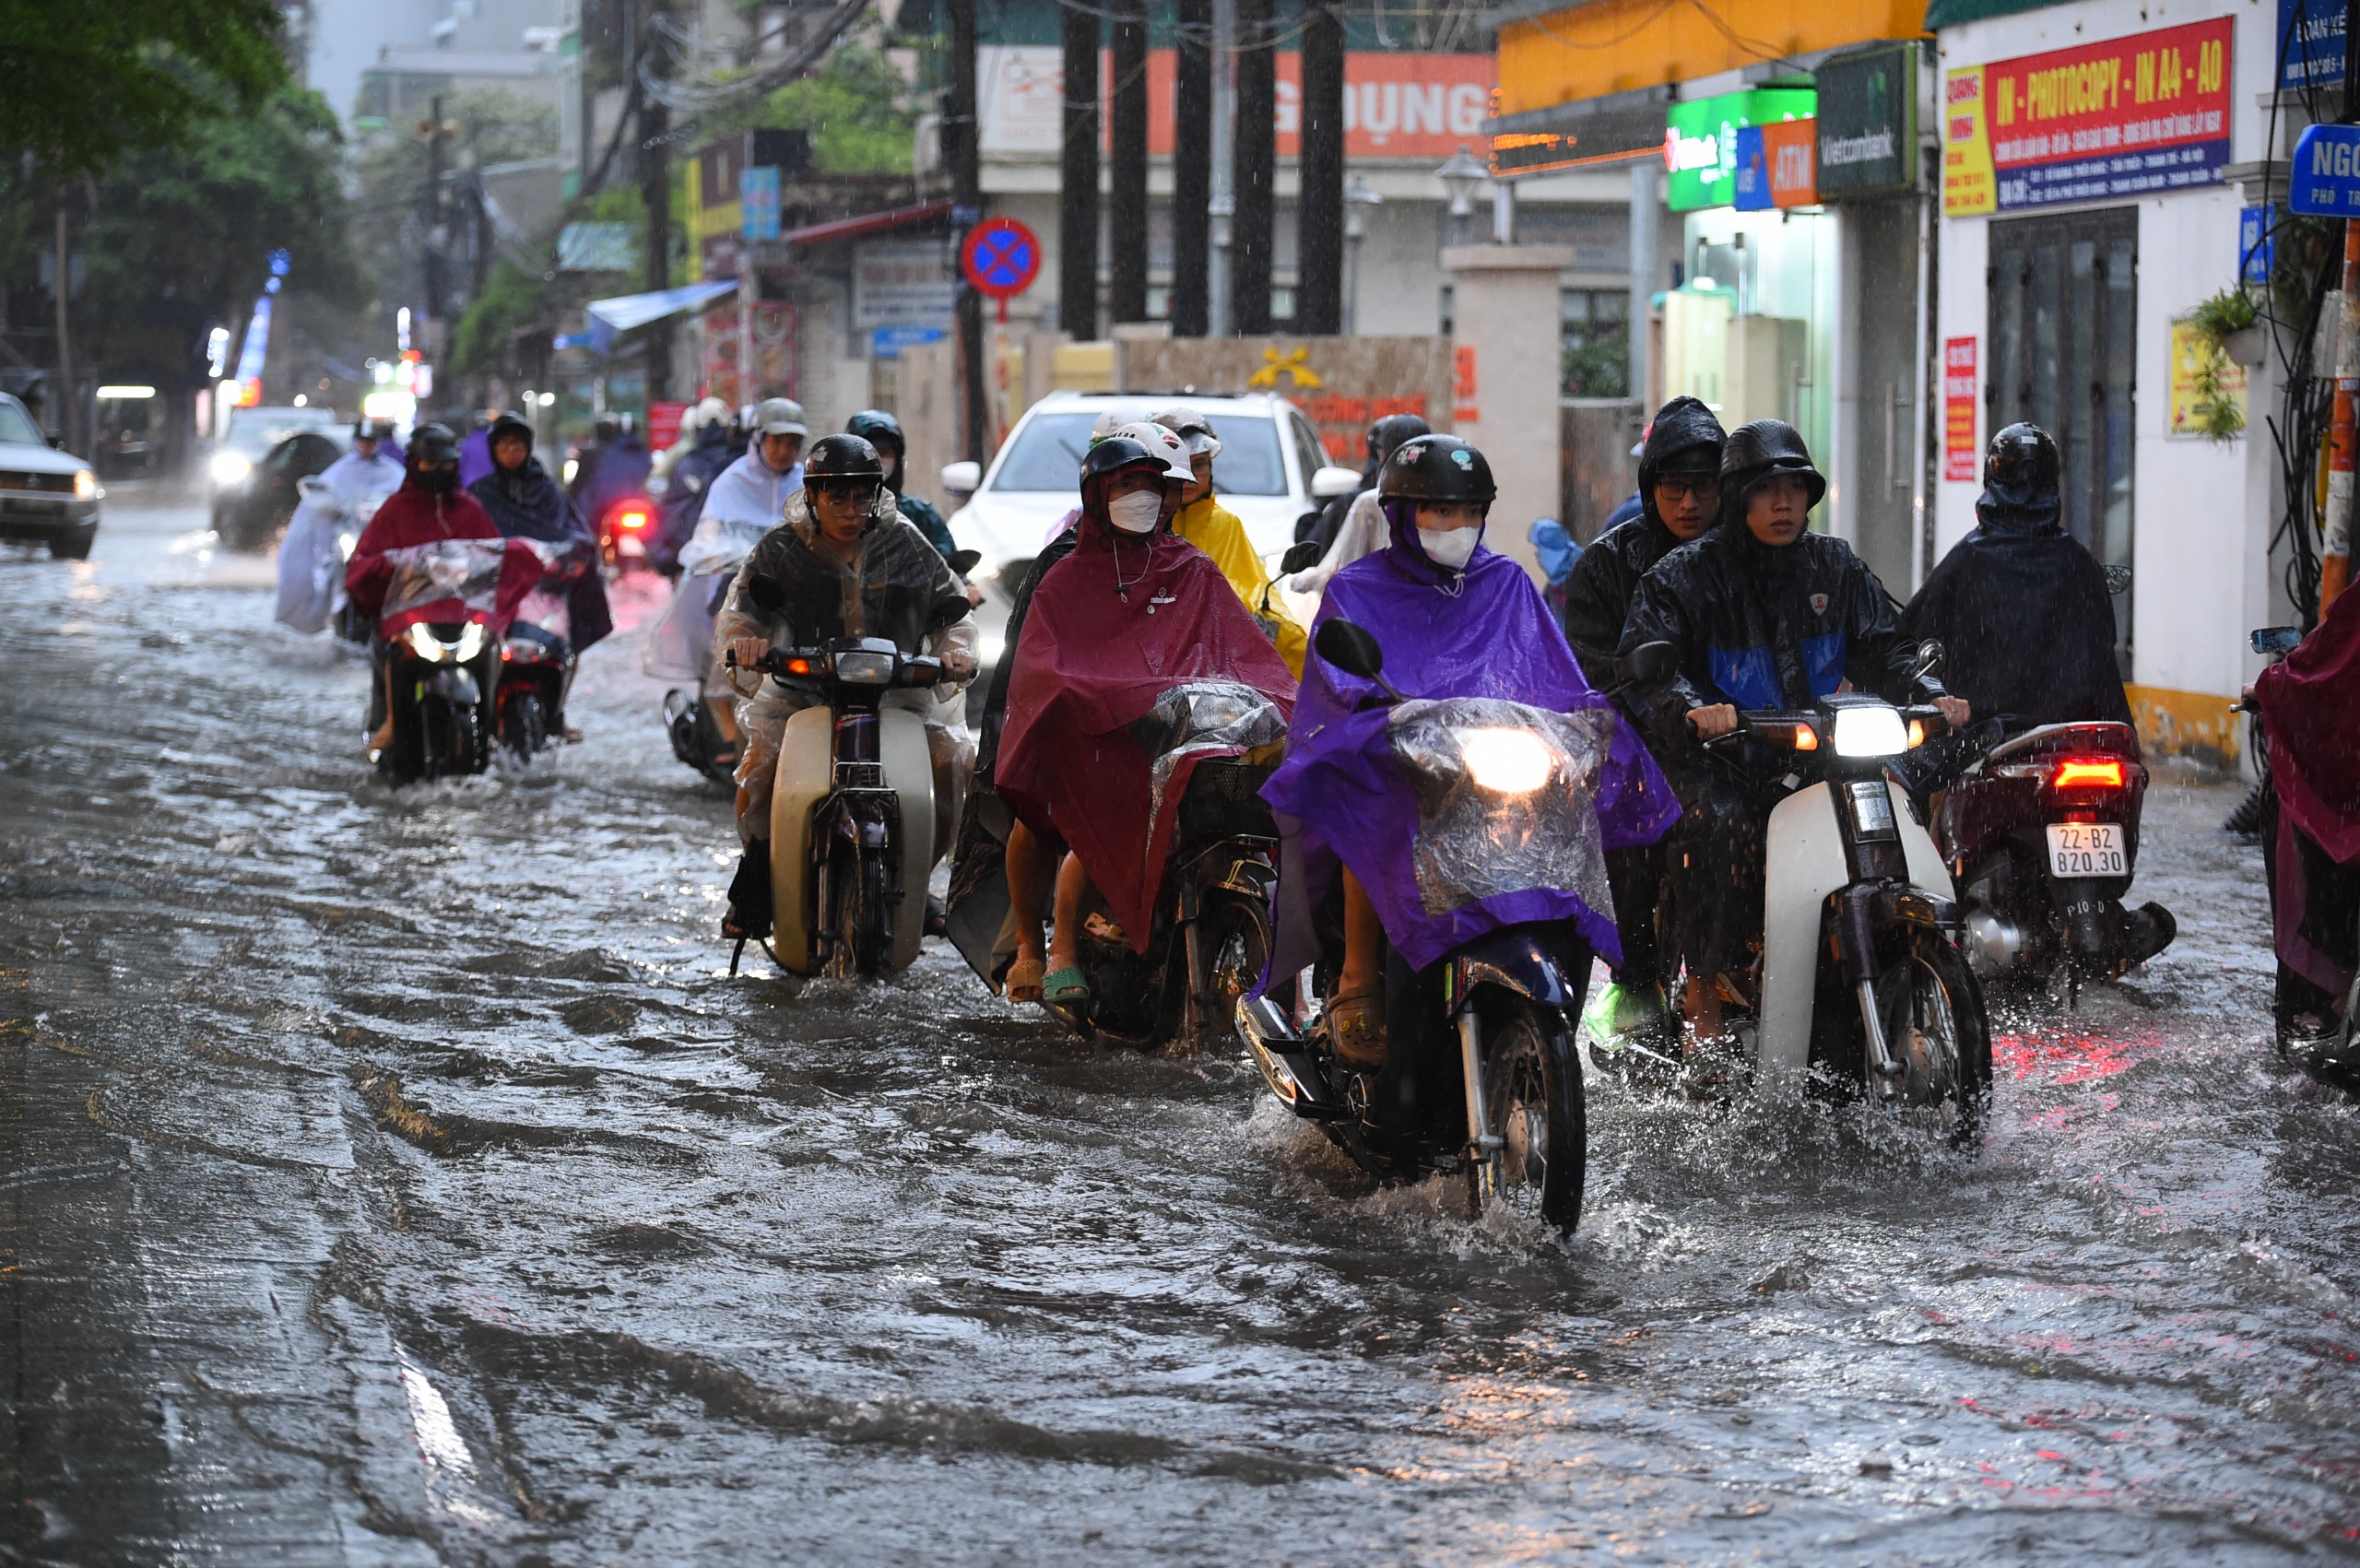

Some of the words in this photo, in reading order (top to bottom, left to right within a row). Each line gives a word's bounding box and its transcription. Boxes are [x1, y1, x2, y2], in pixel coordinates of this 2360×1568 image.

[1997, 76, 2015, 127] IN
[2027, 57, 2121, 122] PHOTOCOPY
[2135, 50, 2155, 104] IN
[2157, 47, 2181, 100] A4
[1774, 144, 1813, 190] ATM
[1820, 124, 1894, 167] Vietcombank
[2059, 828, 2112, 849] 22-B2
[2057, 851, 2121, 873] 820.30
